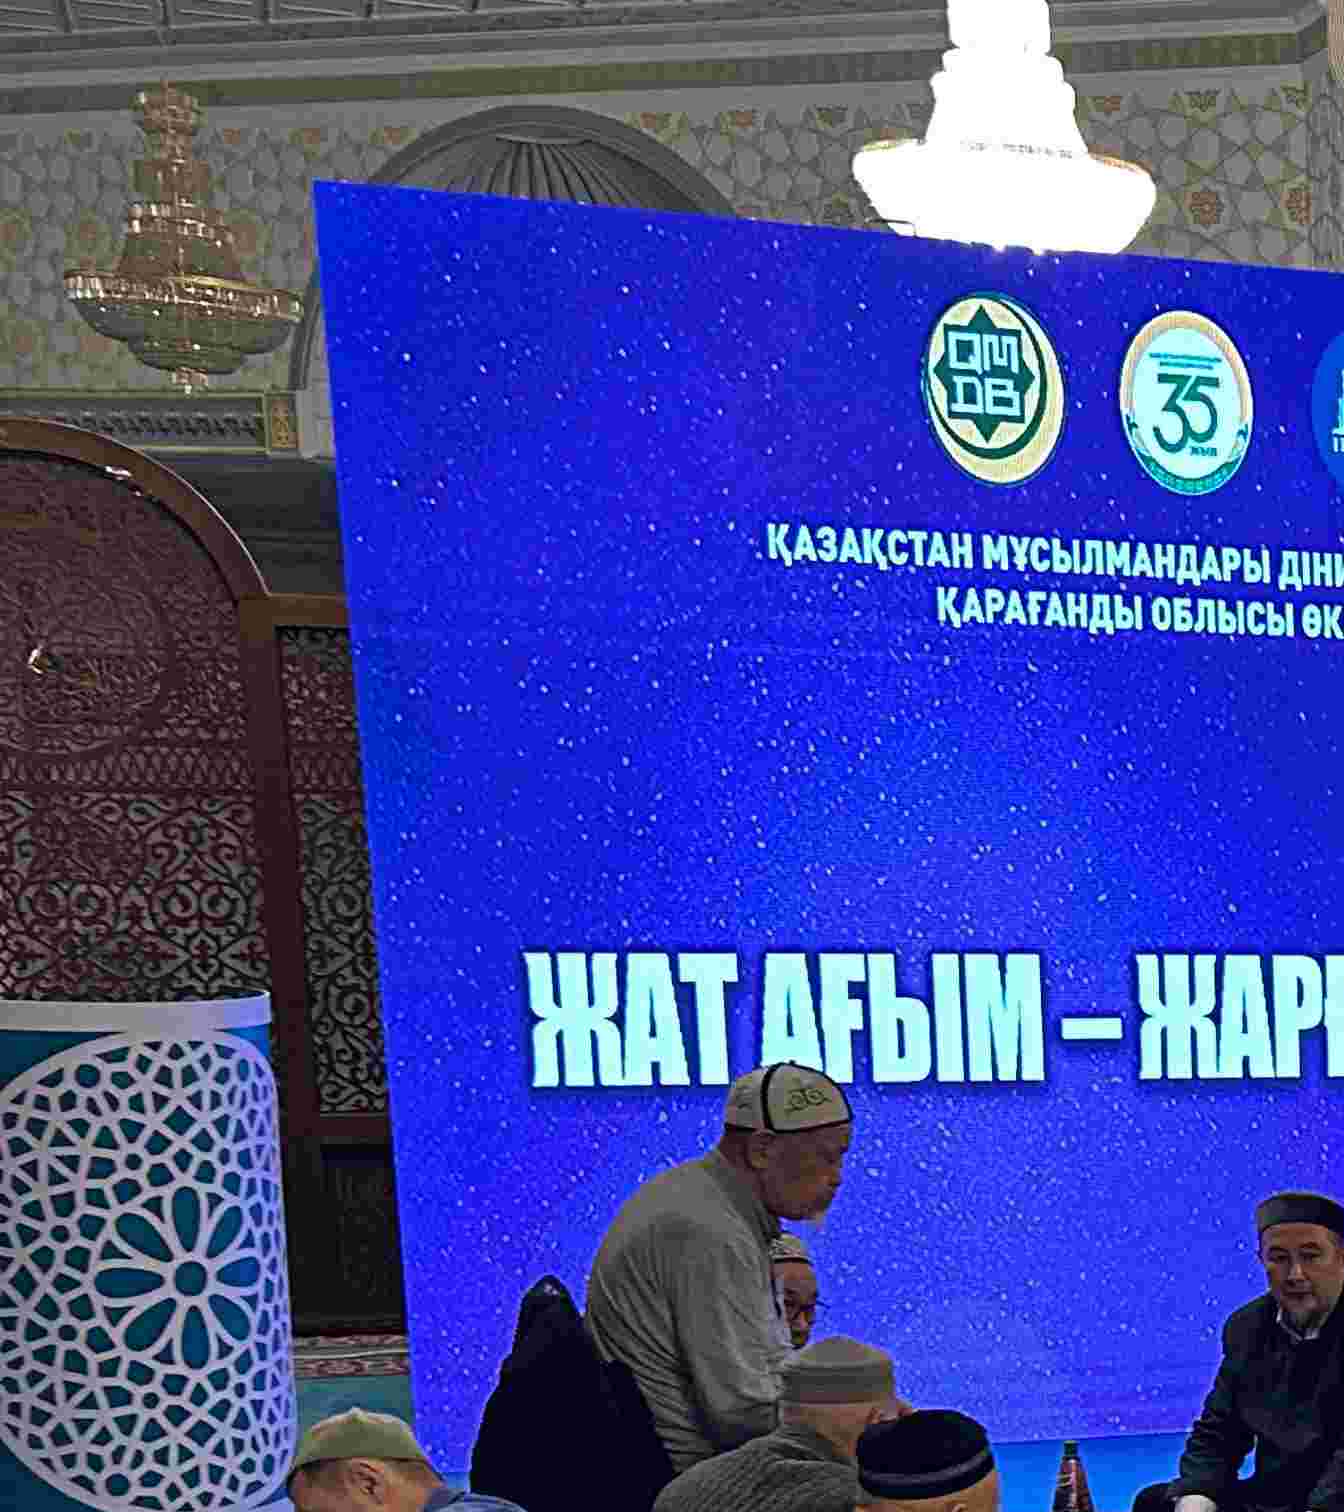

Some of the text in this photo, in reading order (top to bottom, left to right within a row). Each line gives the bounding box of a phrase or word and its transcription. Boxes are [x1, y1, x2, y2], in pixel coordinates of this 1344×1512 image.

[1153, 373, 1220, 453] 35
[767, 522, 974, 571] ҚАЗАҚСТАН
[982, 534, 1271, 586] МҰСЫЛМАНДАРЫ
[936, 586, 1143, 636] ҚАРАҒАНДЫ
[1151, 597, 1295, 638] ОБЛЫСЫ
[522, 951, 739, 1088] ЖАТ
[761, 952, 1046, 1083] АҒЫМ
